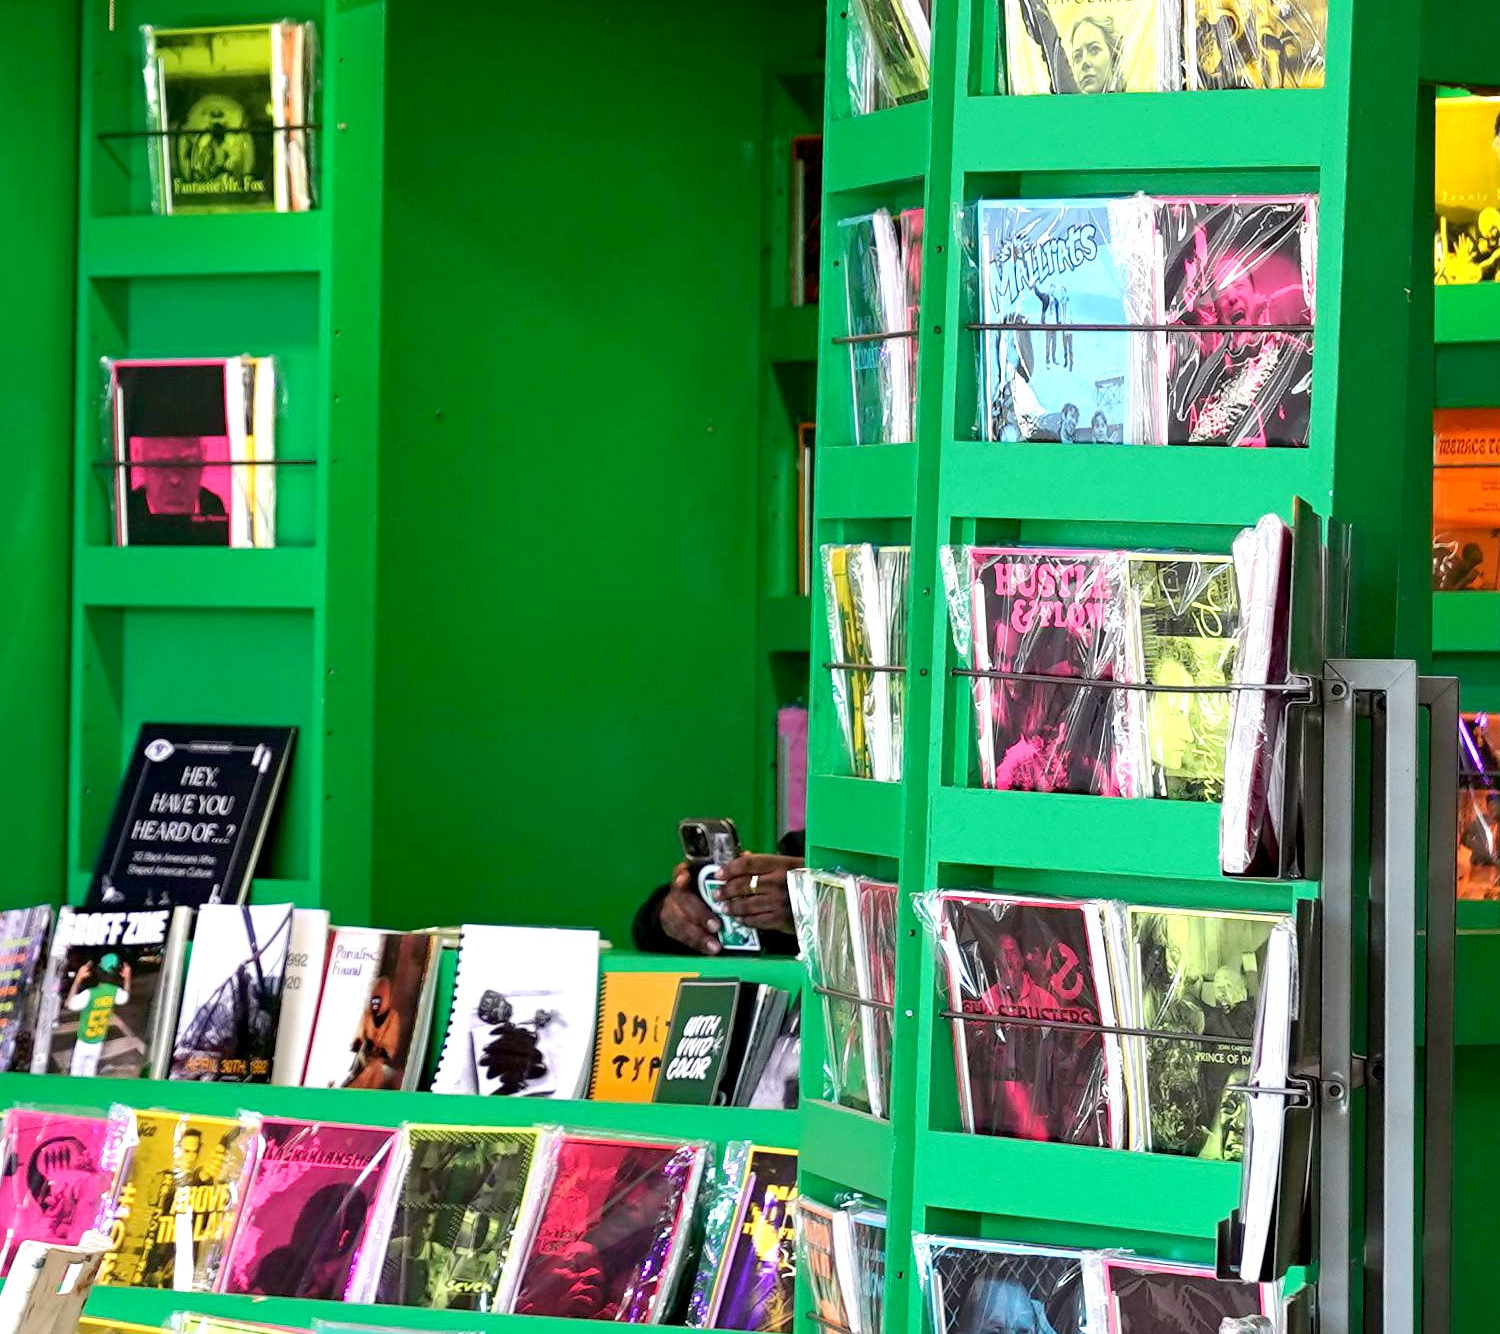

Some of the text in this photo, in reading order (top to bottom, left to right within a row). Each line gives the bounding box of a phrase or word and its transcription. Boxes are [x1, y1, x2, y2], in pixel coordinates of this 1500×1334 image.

[174, 176, 264, 194] Fantastic Mr. Fox
[1439, 435, 1485, 455] MENACE
[180, 766, 221, 788] HEY.
[149, 792, 236, 816] HAVE YOU
[131, 819, 193, 842] HEARD
[963, 999, 1094, 1026] GHSTBUSTERS
[683, 1015, 722, 1037] WITH
[676, 1036, 714, 1058] VIVID
[665, 1056, 712, 1080] COLOR
[1227, 1054, 1239, 1064] OF
